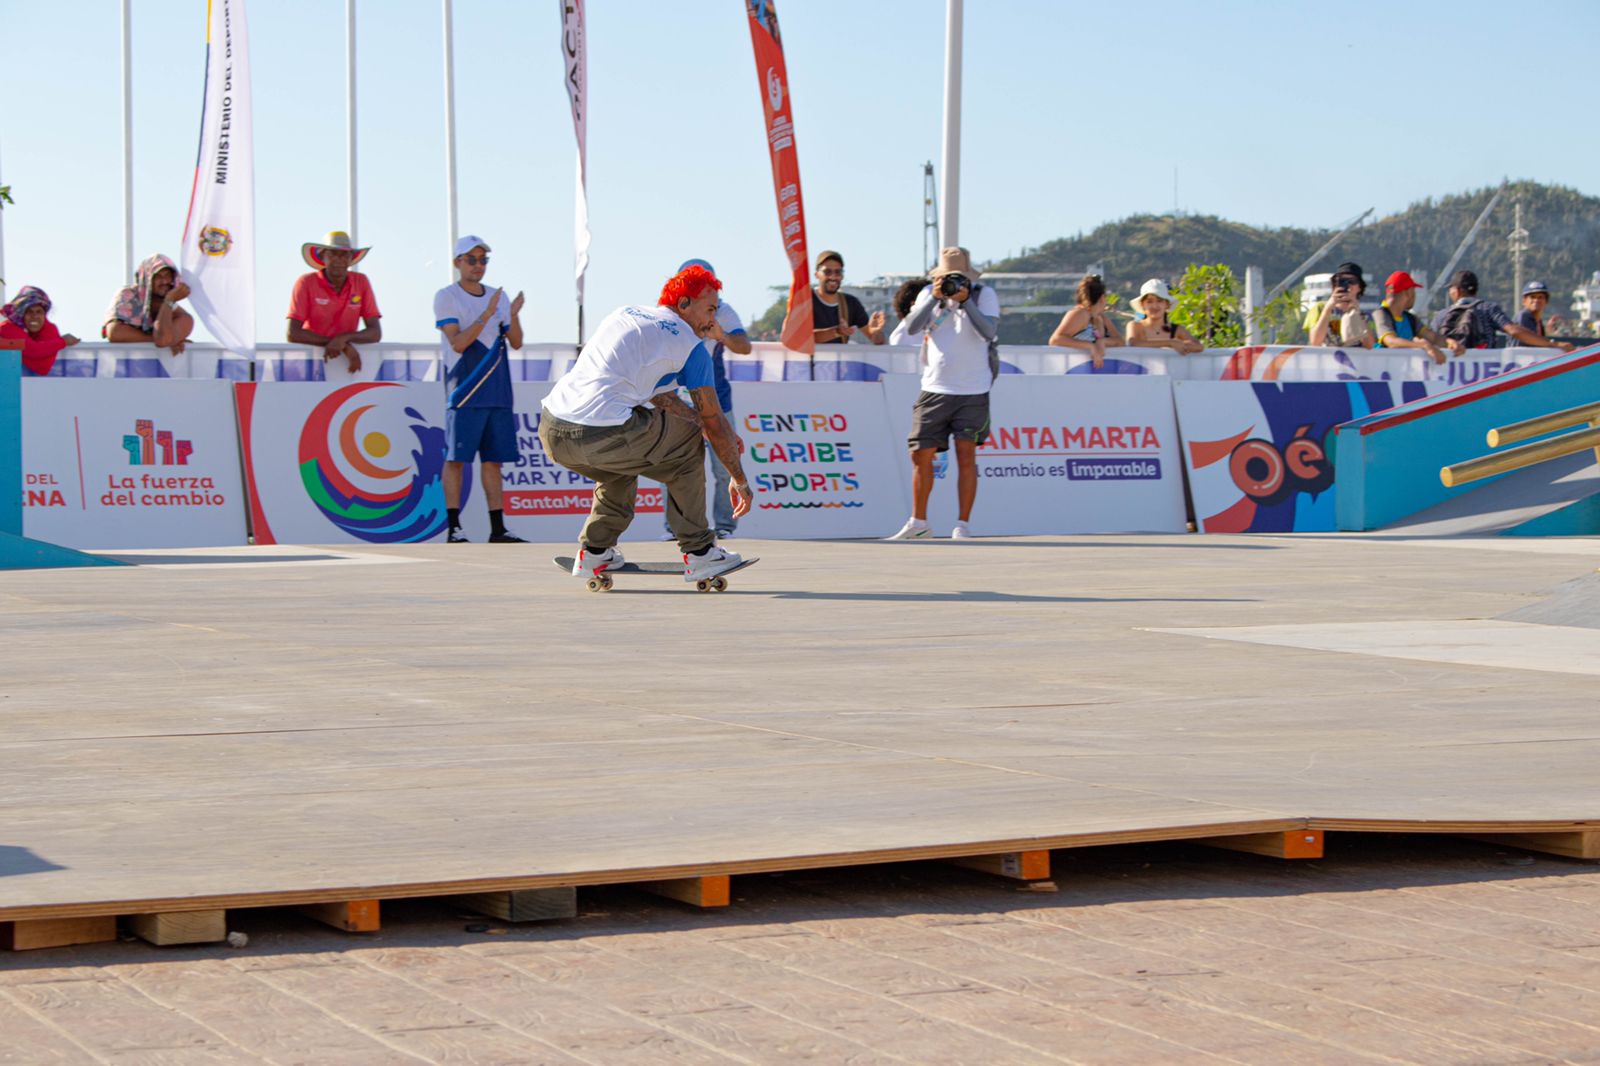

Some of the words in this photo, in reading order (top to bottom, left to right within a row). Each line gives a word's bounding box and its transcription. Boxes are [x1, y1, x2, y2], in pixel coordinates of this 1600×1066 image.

[215, 96, 232, 184] MINISTERIO
[224, 61, 233, 92] DEL
[744, 414, 848, 433] CENTRO
[1062, 426, 1161, 449] MARTA
[750, 442, 854, 463] CARIBE
[26, 473, 59, 485] DEL
[502, 471, 546, 486] MAR
[549, 471, 562, 485] Y
[984, 462, 1045, 478] cambio
[1049, 464, 1066, 477] es
[1072, 461, 1157, 480] imparable
[108, 474, 136, 489] La
[141, 474, 214, 489] fuerza
[755, 472, 859, 492] SPORTS
[100, 490, 136, 506] del
[141, 490, 225, 506] cambio
